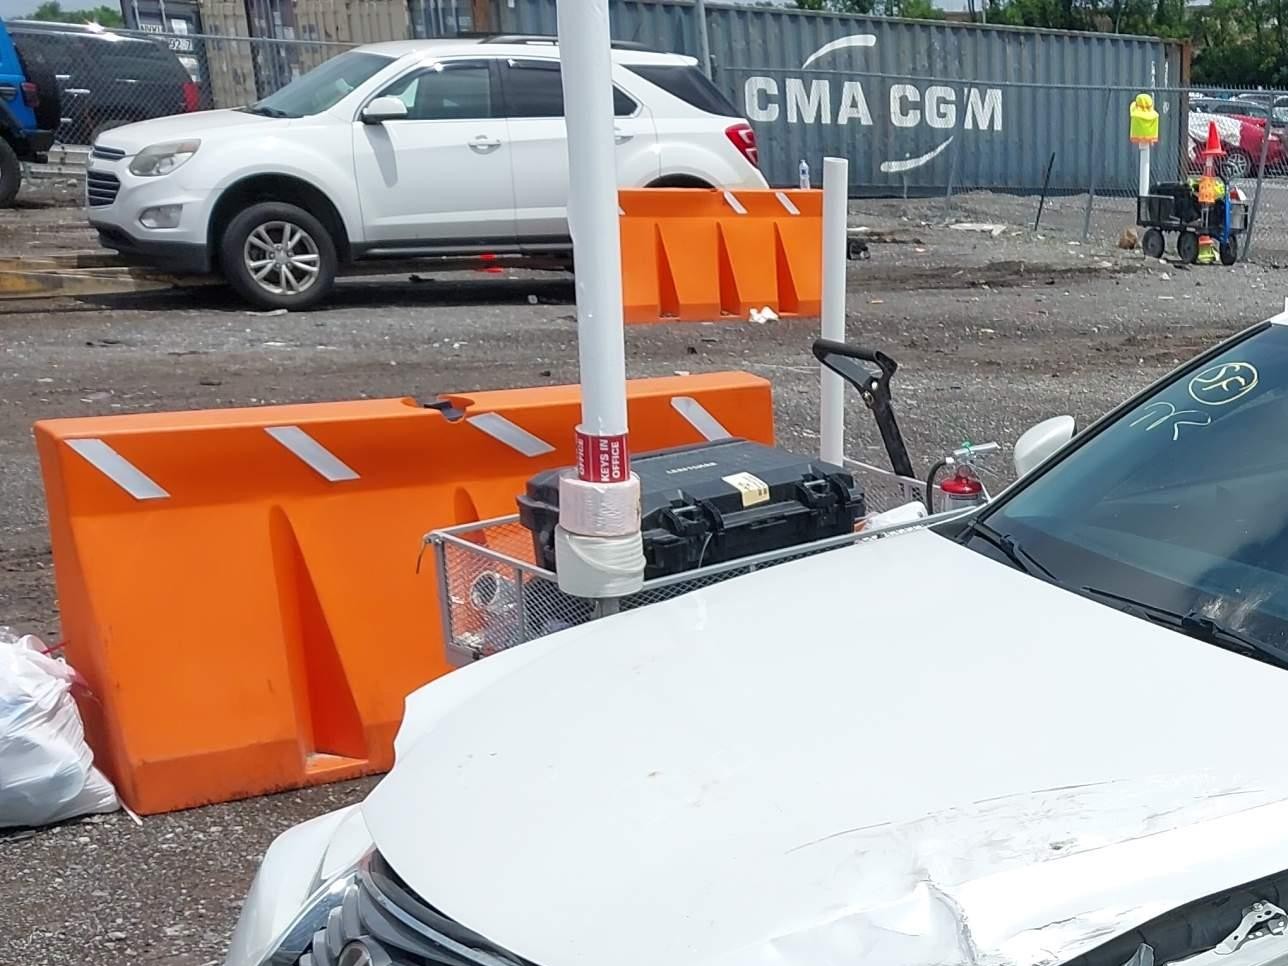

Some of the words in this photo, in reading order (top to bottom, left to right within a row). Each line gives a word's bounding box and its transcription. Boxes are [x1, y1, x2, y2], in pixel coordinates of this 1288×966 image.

[744, 76, 873, 125] CMA
[889, 84, 1003, 131] CGM
[600, 439, 610, 452] IN
[611, 441, 620, 479] OFFICE
[600, 454, 610, 482] KEYS
